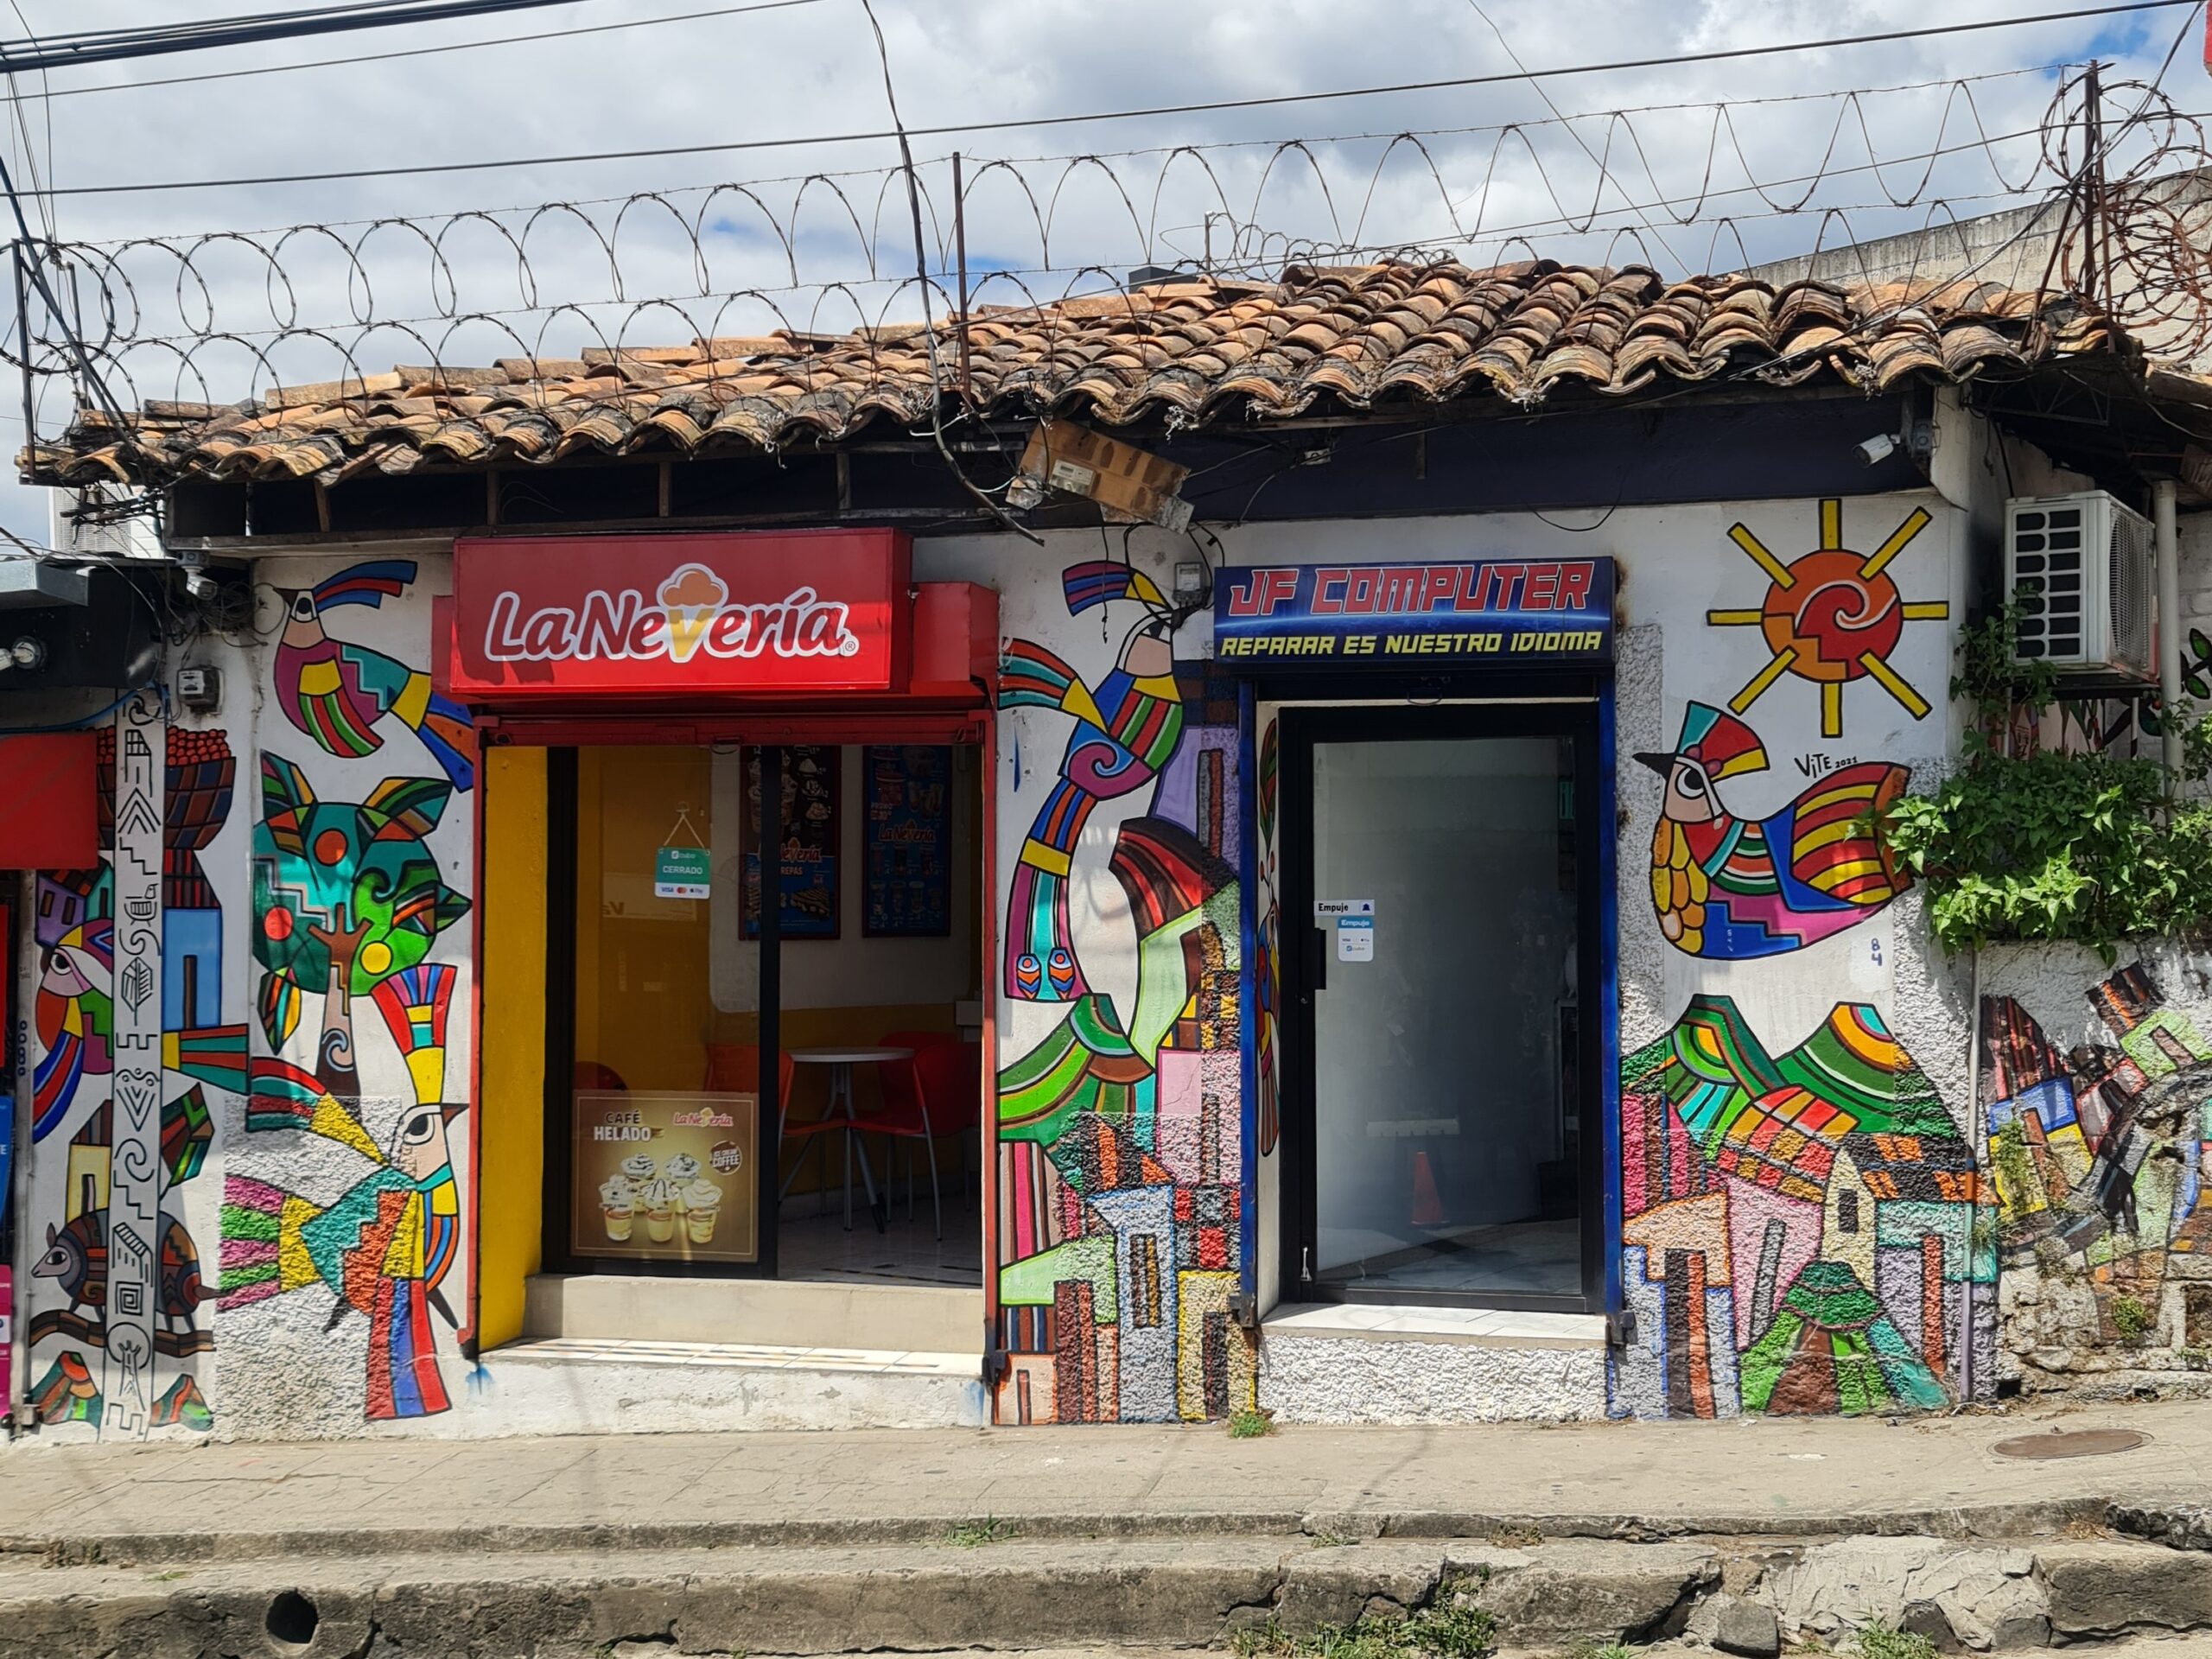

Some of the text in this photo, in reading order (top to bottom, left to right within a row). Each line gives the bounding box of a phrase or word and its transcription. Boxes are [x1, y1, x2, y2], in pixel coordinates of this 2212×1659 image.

[1229, 562, 1594, 615] JF COMPUTER
[1221, 631, 1602, 656] REPARAR ES NUESTRO IDIOMA
[1834, 756, 1859, 768] 2021
[663, 865, 703, 874] CERRADO
[1319, 902, 1349, 912] Empuje
[606, 1109, 640, 1123] CAFÉ
[594, 1126, 652, 1141] HELADO
[713, 1155, 741, 1167] COFFEE
